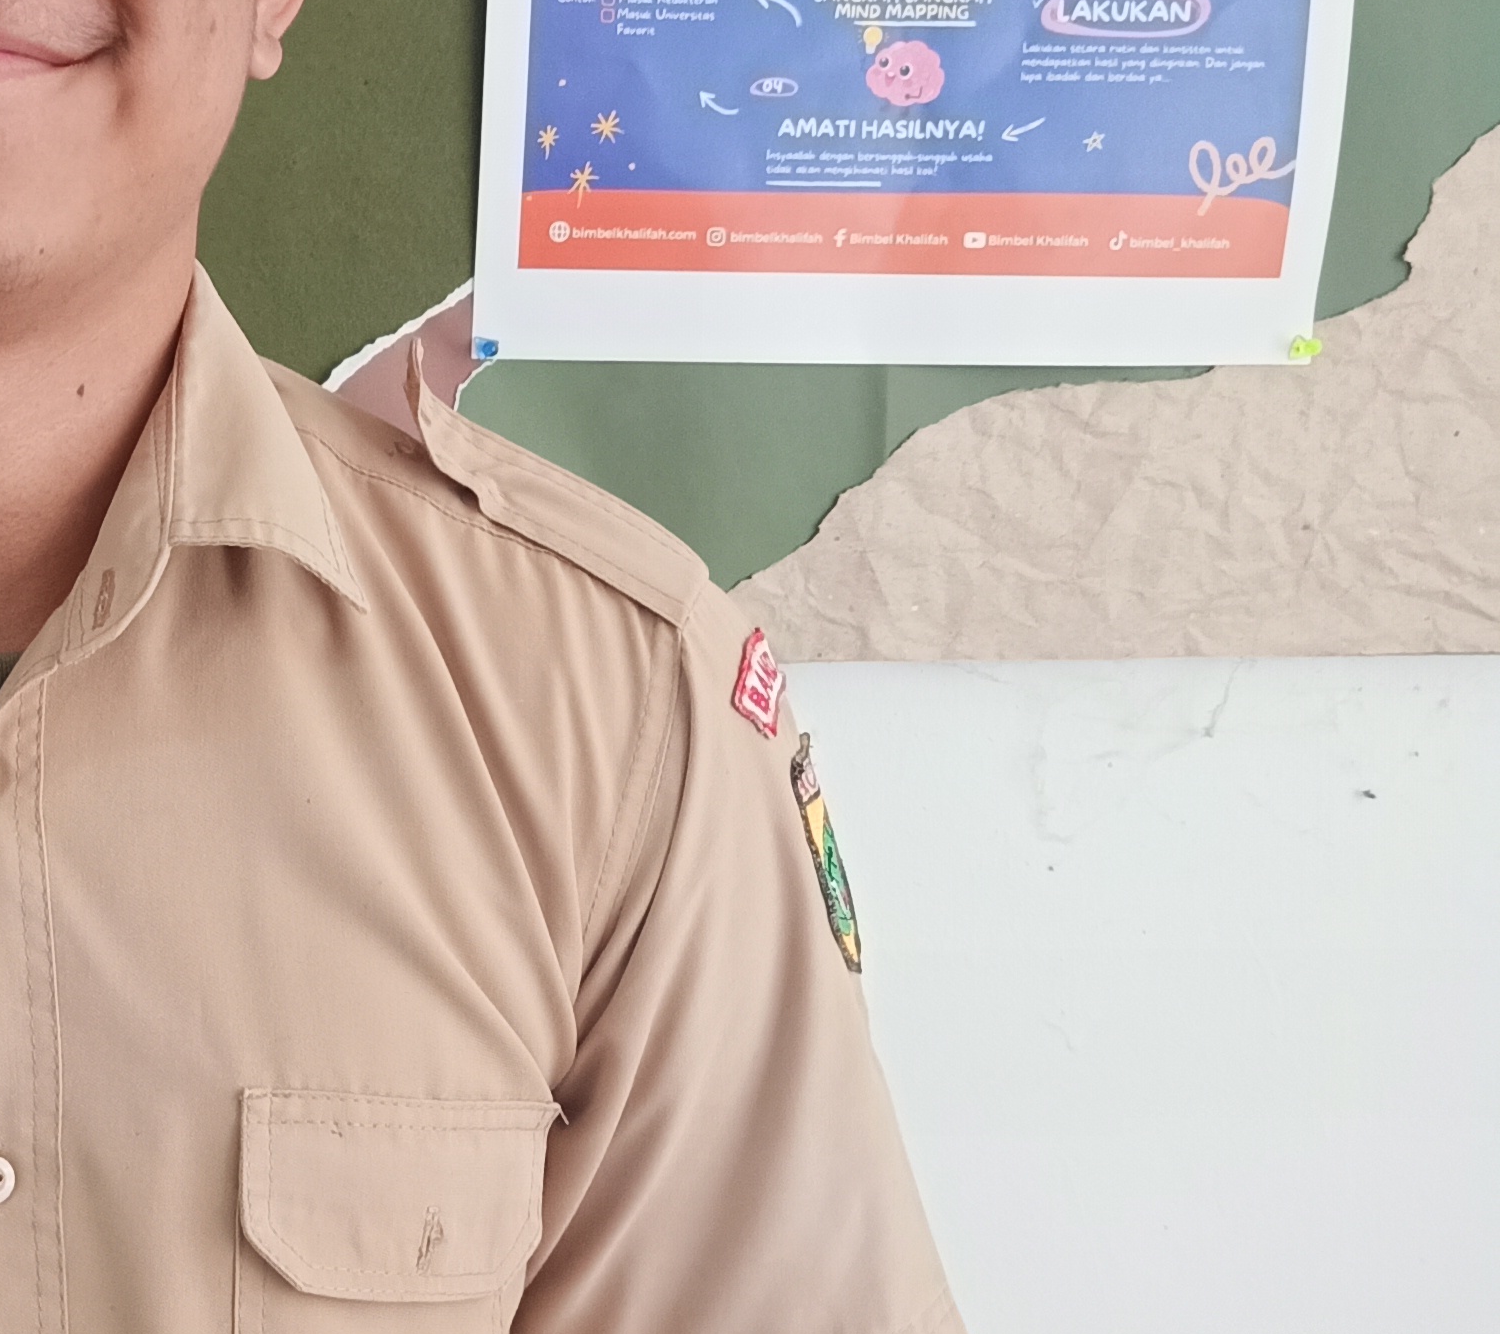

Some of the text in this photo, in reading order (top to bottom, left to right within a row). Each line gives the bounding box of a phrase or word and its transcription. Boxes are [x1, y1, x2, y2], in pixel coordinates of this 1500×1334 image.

[835, 4, 969, 20] MIND MAPPING
[762, 79, 783, 93] 04
[778, 118, 986, 141] AMATI HASILNYA!
[572, 227, 697, 242] bimbelkhalifah.com
[850, 233, 949, 246] Bimbel Khalifah
[988, 234, 1089, 247] Bimbel Khalifah
